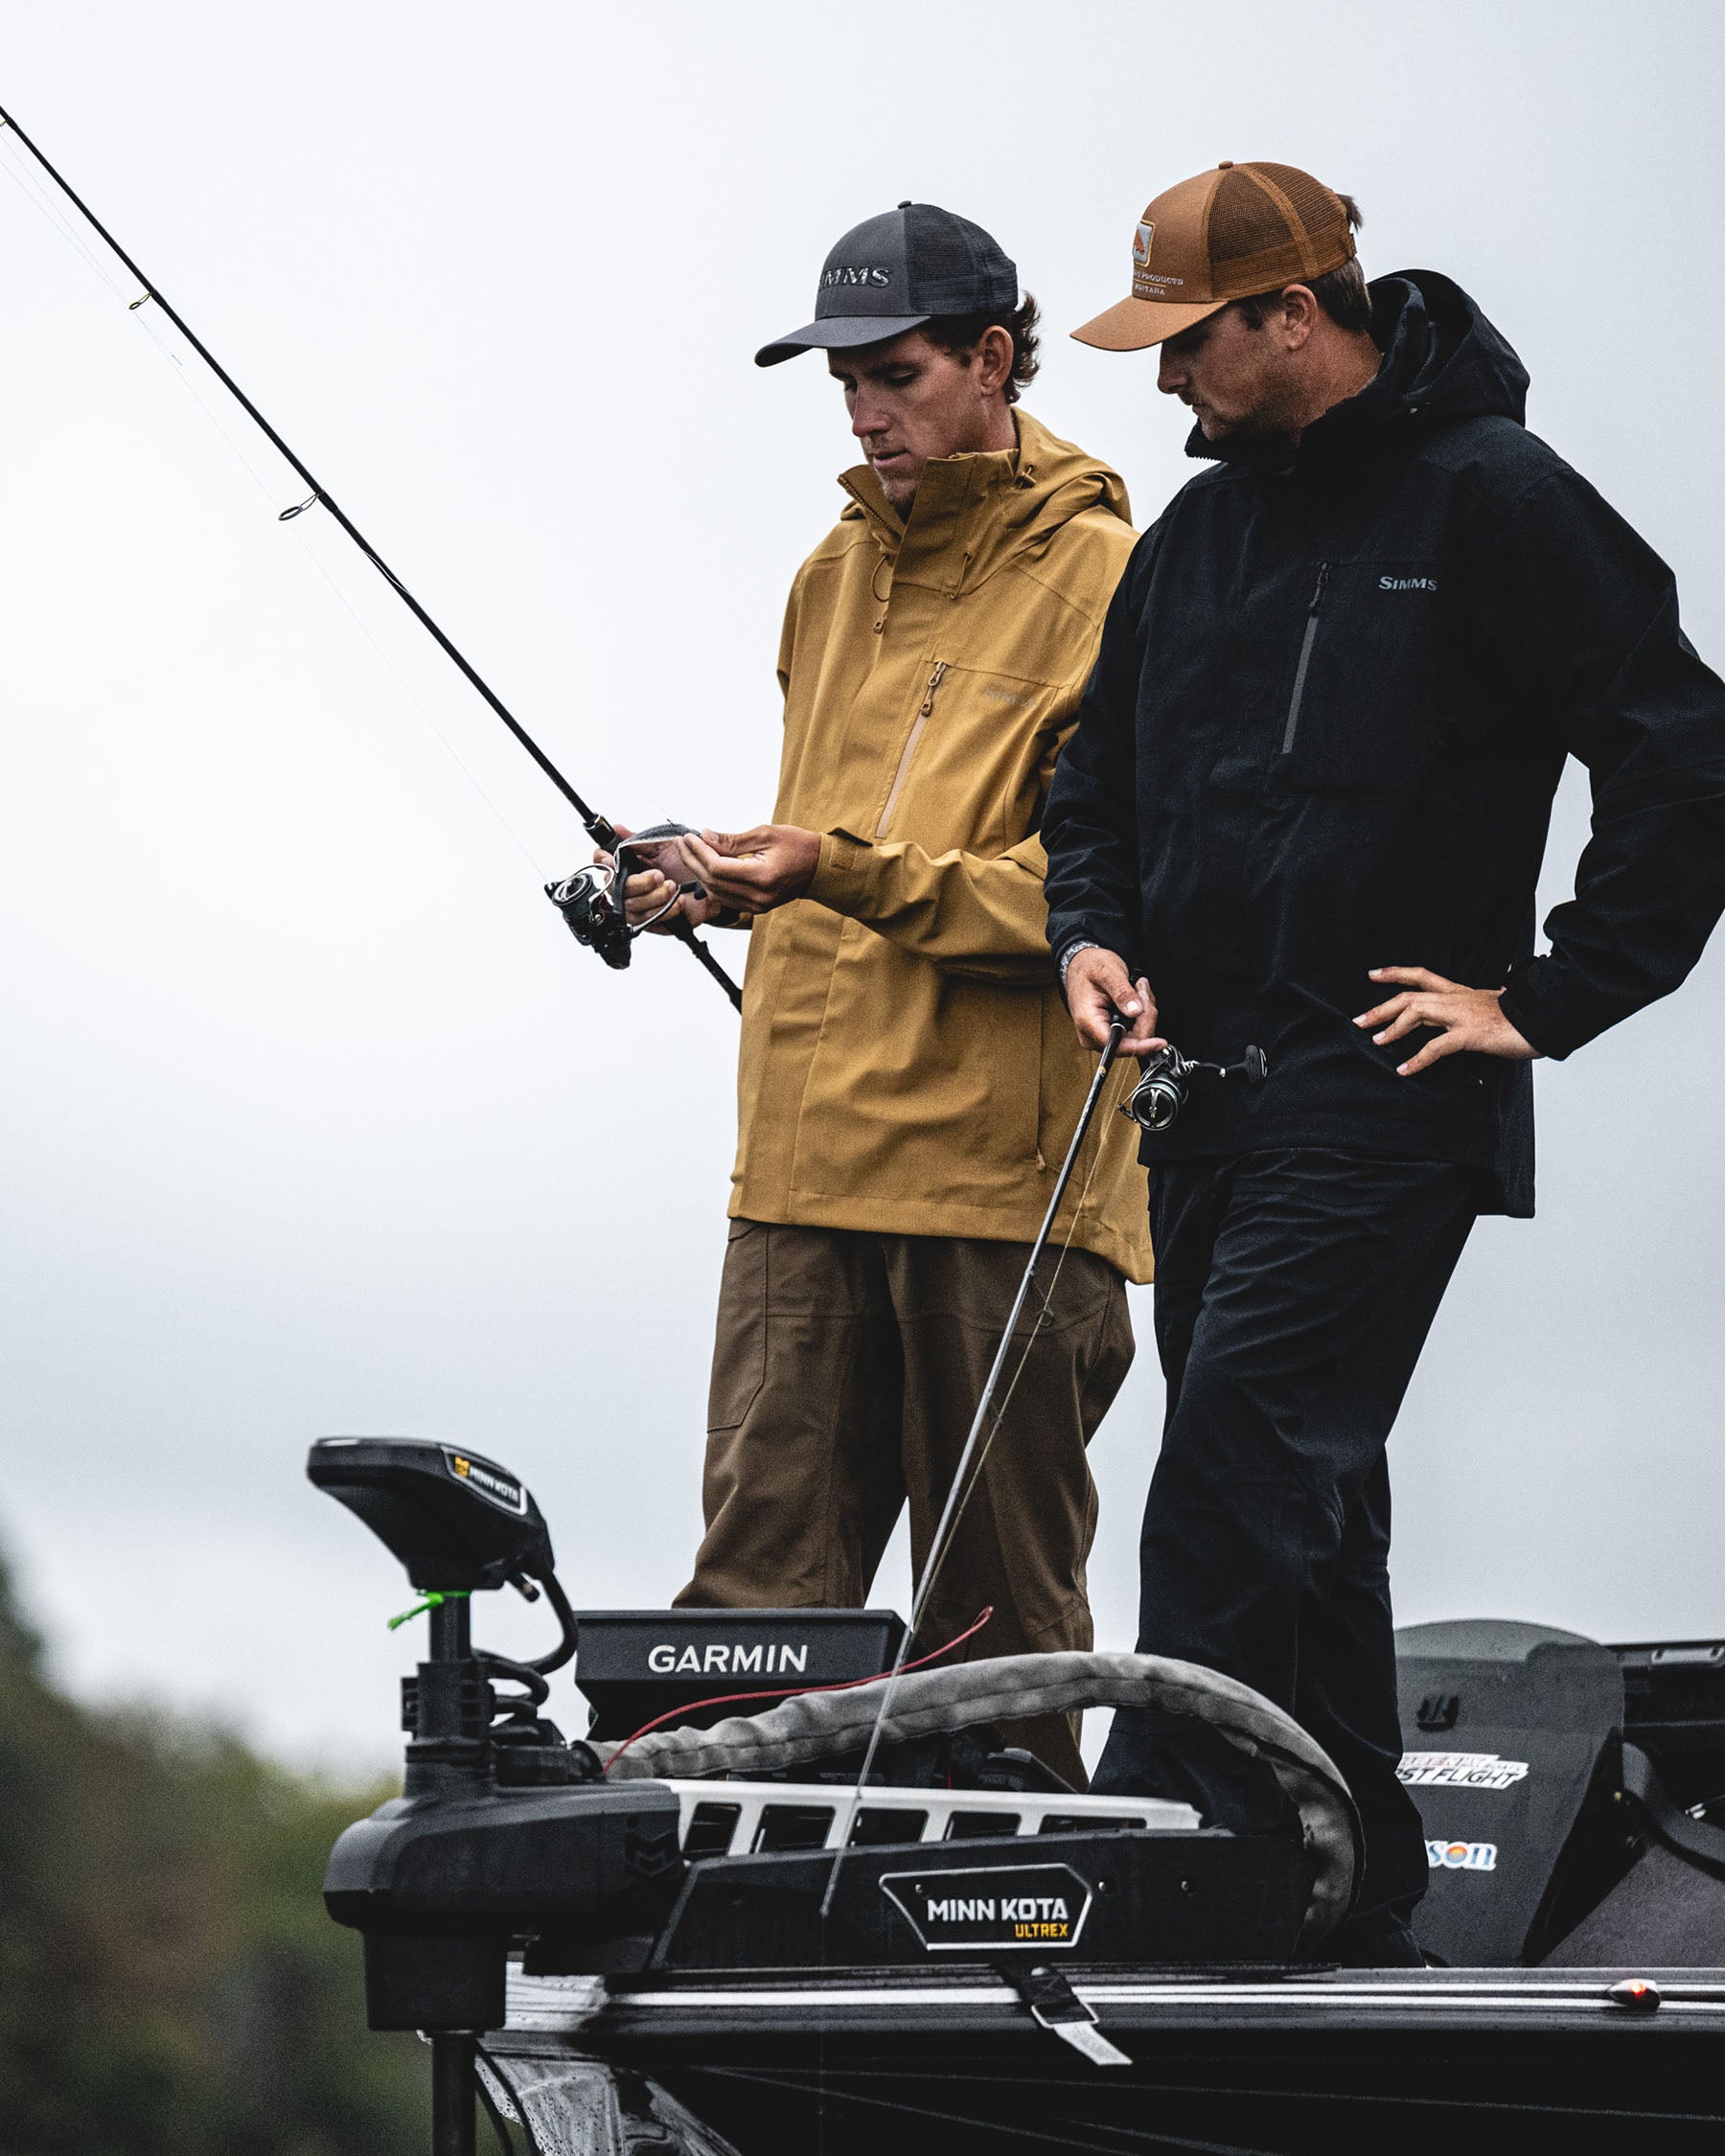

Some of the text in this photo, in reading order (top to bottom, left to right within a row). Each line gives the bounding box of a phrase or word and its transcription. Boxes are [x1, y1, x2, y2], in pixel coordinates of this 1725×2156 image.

[820, 267, 889, 287] MMS
[1379, 576, 1438, 591] SIMMS
[648, 1644, 808, 1673] GARMIN
[1434, 1769, 1518, 1785] FLIGHT
[928, 1898, 1069, 1921] MINN KOTA
[1015, 1923, 1069, 1938] ULTREX
